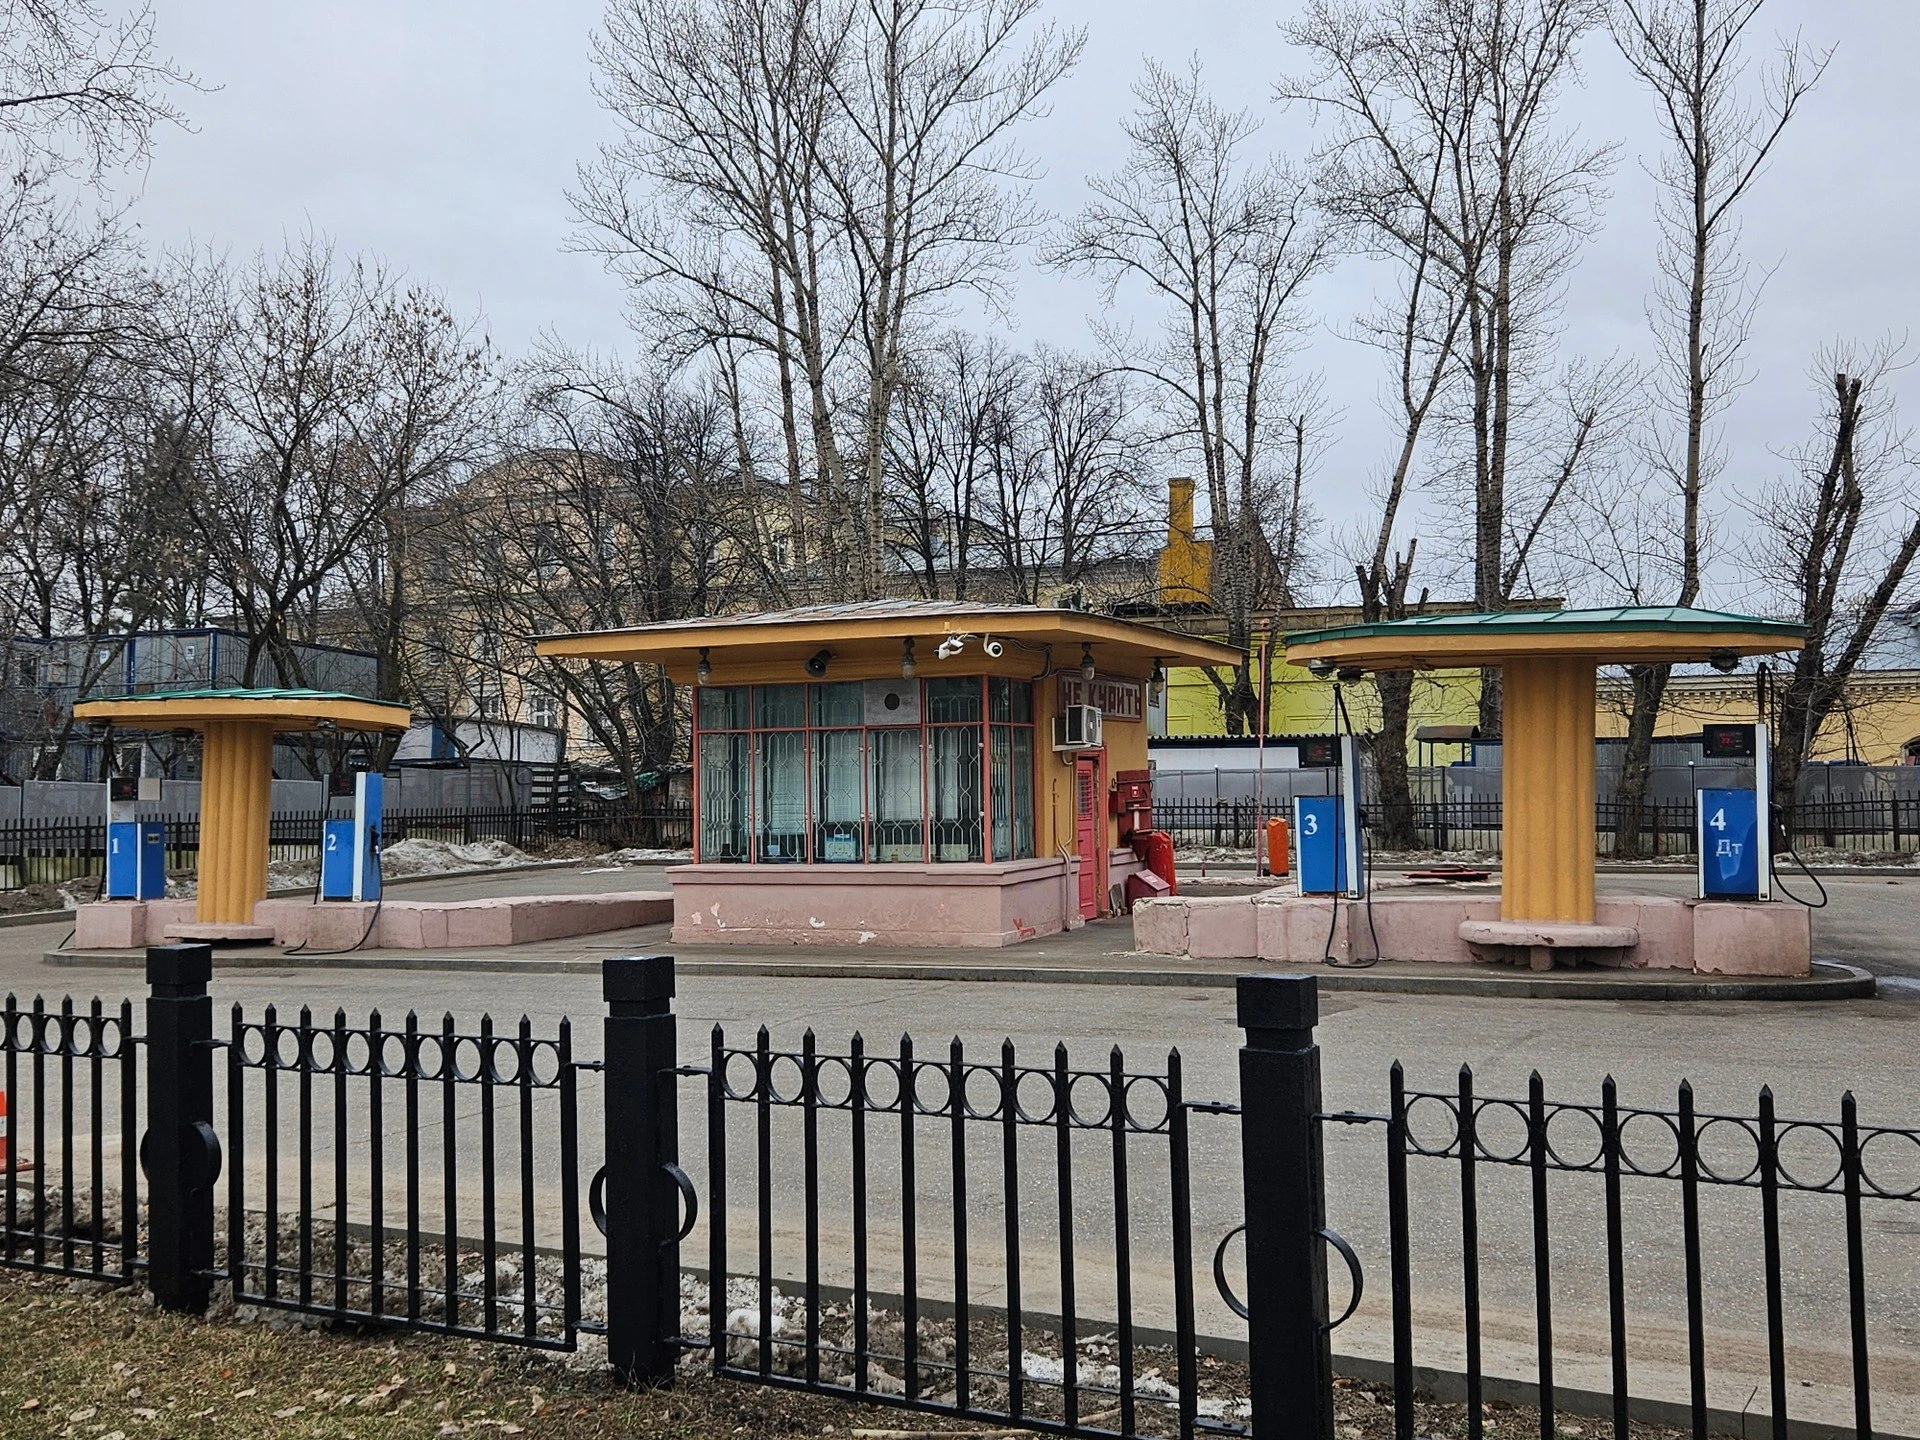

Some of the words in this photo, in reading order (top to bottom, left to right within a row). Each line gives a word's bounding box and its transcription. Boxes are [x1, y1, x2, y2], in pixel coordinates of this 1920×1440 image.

[1062, 680, 1083, 707] НЕ
[1088, 683, 1141, 716] КУРИТЬ
[1304, 813, 1318, 835] 3
[1710, 808, 1726, 831] 4
[112, 838, 119, 854] 1
[327, 834, 336, 851] 2
[1716, 839, 1743, 857] Дт
